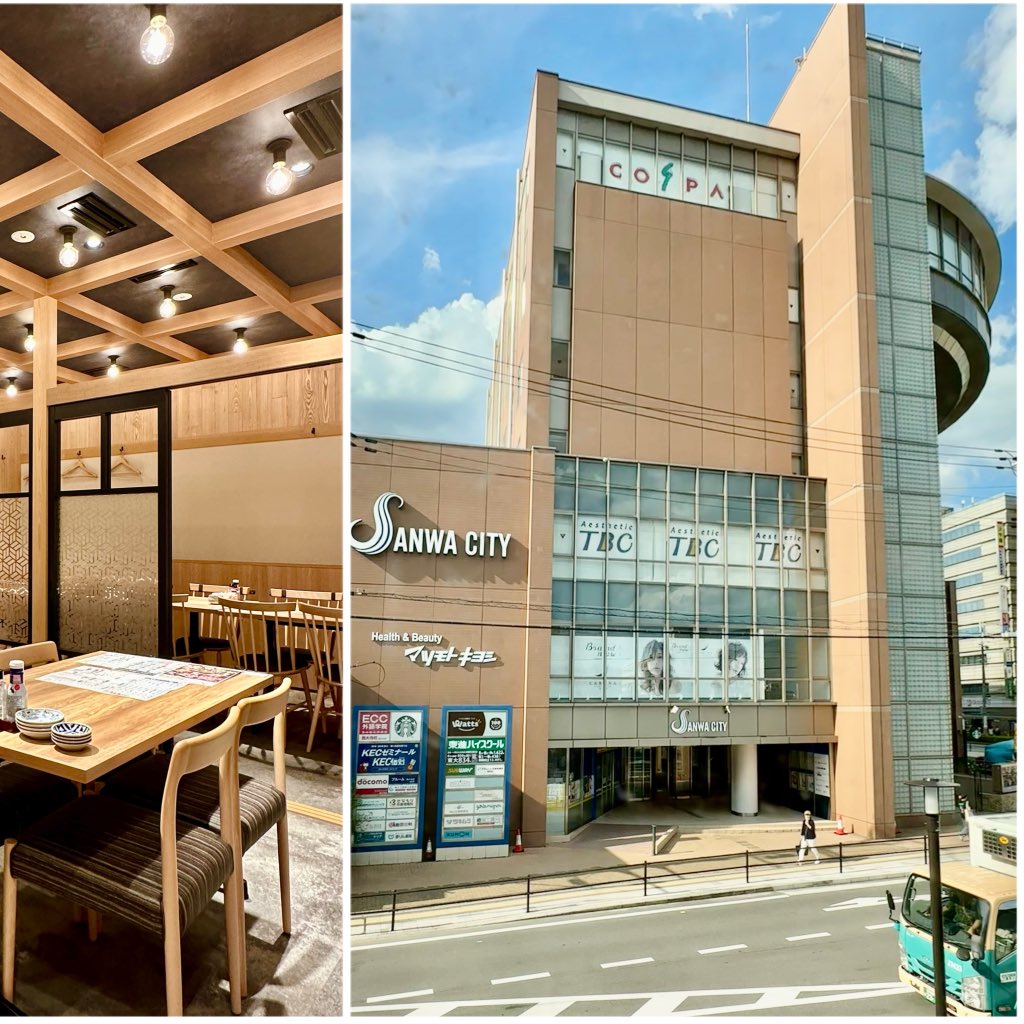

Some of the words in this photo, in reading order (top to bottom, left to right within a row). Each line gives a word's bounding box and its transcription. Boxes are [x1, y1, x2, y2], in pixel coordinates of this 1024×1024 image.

[609, 162, 724, 201] COSPA
[350, 492, 458, 555] SANWA
[465, 531, 511, 558] CITY
[670, 527, 720, 537] Aestetic
[755, 532, 802, 542] Aestetic
[579, 530, 633, 553] TBC
[371, 631, 401, 641] Health
[402, 633, 410, 642] &
[411, 632, 443, 644] Beauty
[404, 645, 497, 667] マツモトキヨシ
[362, 714, 388, 723] ECC
[671, 709, 710, 735] SANWA
[711, 721, 728, 732] CITY
[448, 739, 505, 750] 東進ハイスクール
[361, 748, 417, 757] KECゼミナール
